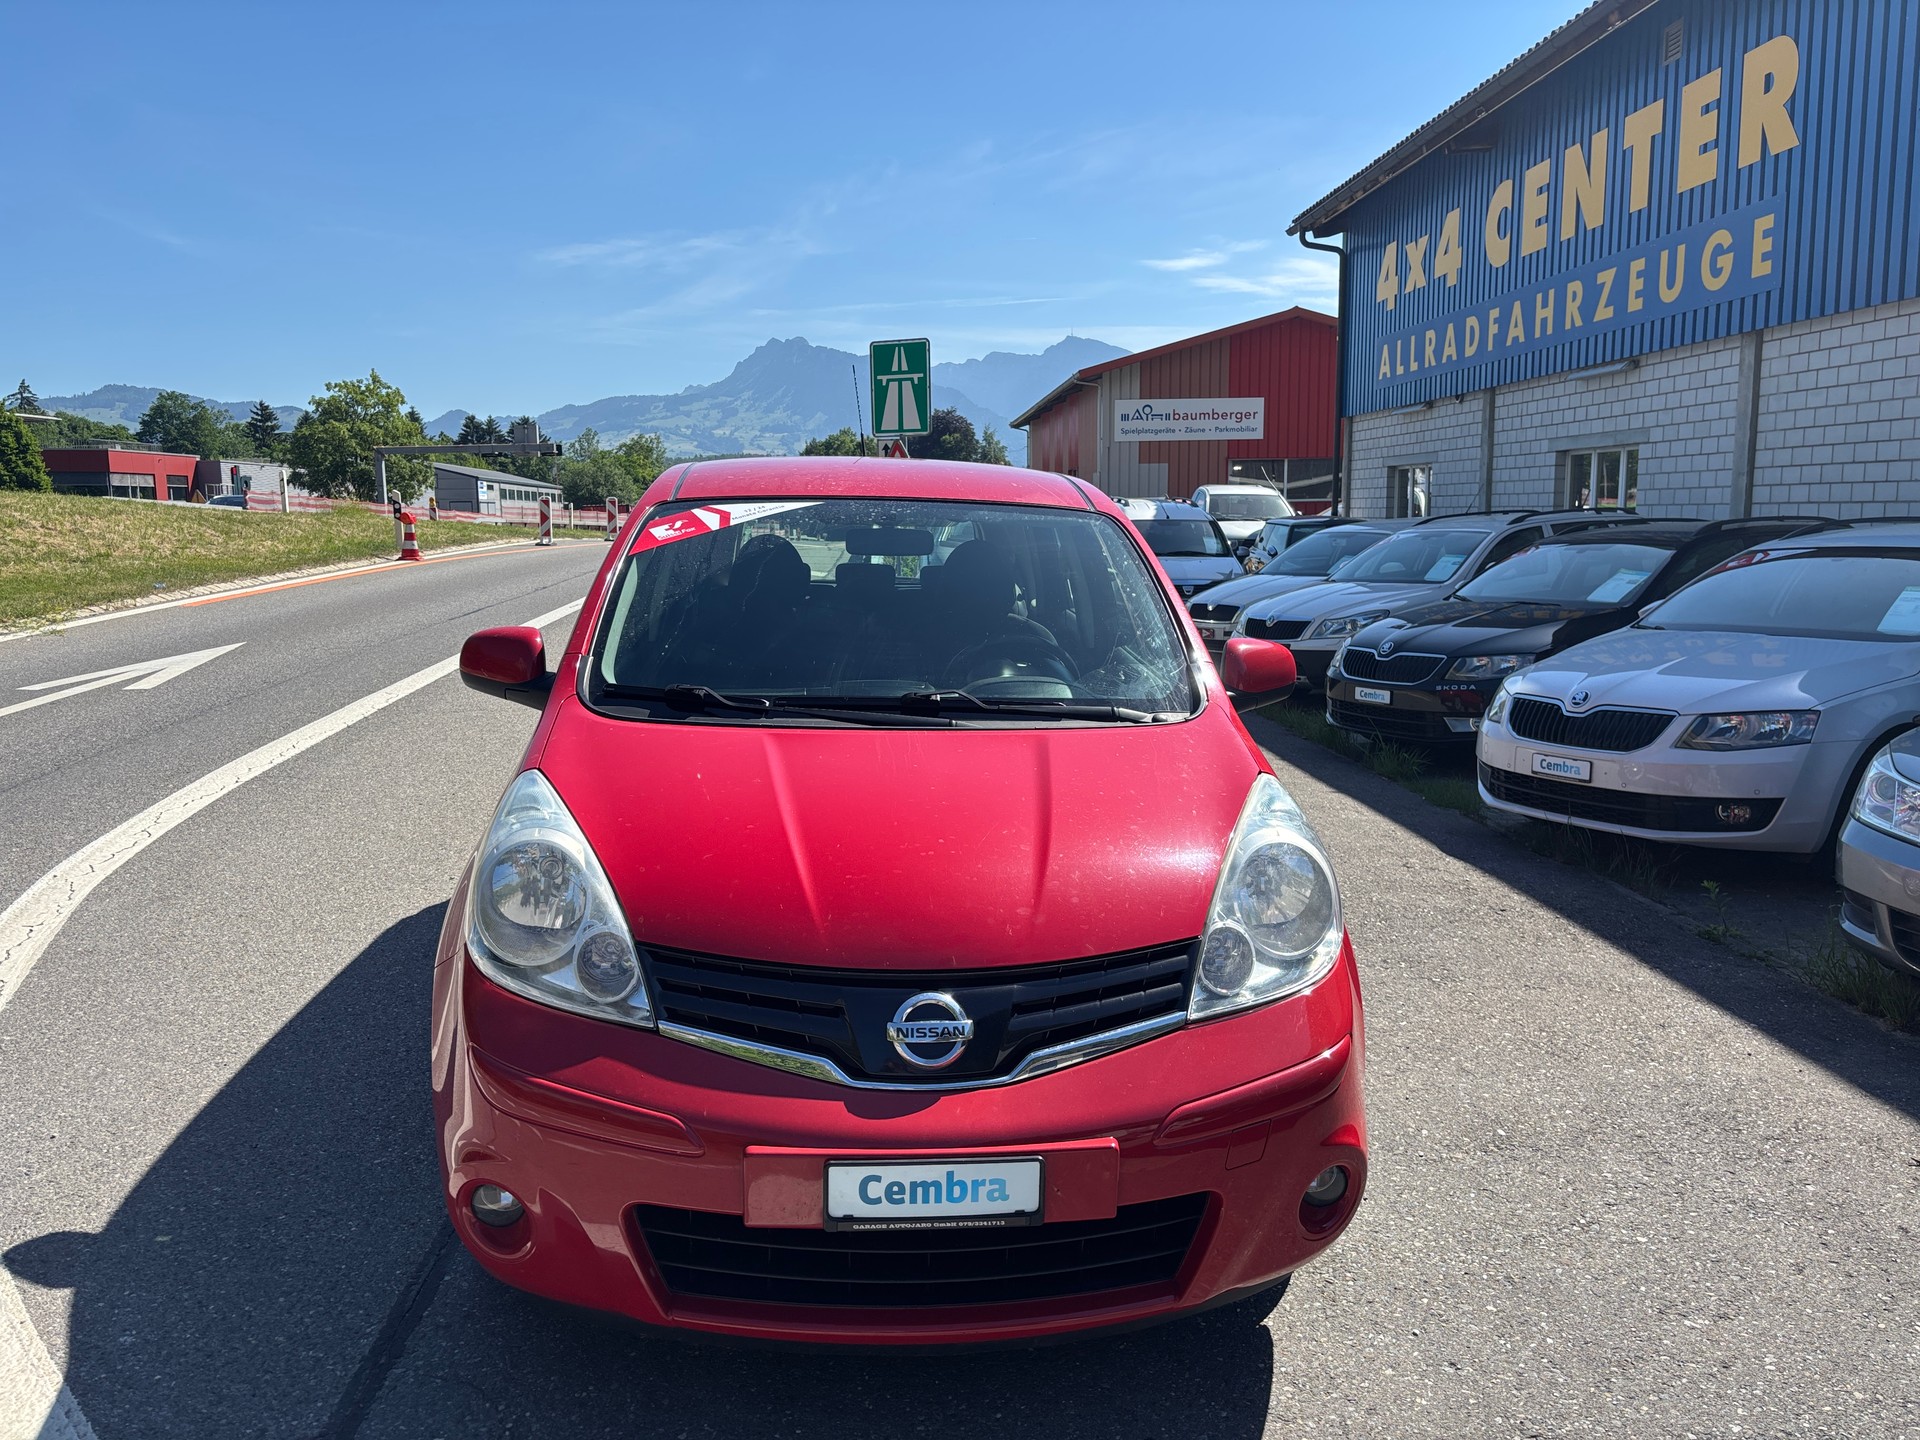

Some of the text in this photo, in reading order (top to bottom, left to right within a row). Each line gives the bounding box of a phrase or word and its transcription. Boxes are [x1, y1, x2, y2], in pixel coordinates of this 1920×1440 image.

[1376, 34, 1801, 312] 4x4 CENTER
[1378, 213, 1776, 380] ALLRADFAHRZEUGE
[1172, 408, 1258, 424] baumberger
[1120, 427, 1176, 436] Spielplatzgeräte
[1360, 690, 1386, 701] Cembra
[1540, 758, 1582, 776] Cembra
[896, 1025, 966, 1039] NISSAN
[858, 1170, 1010, 1206] Cembra
